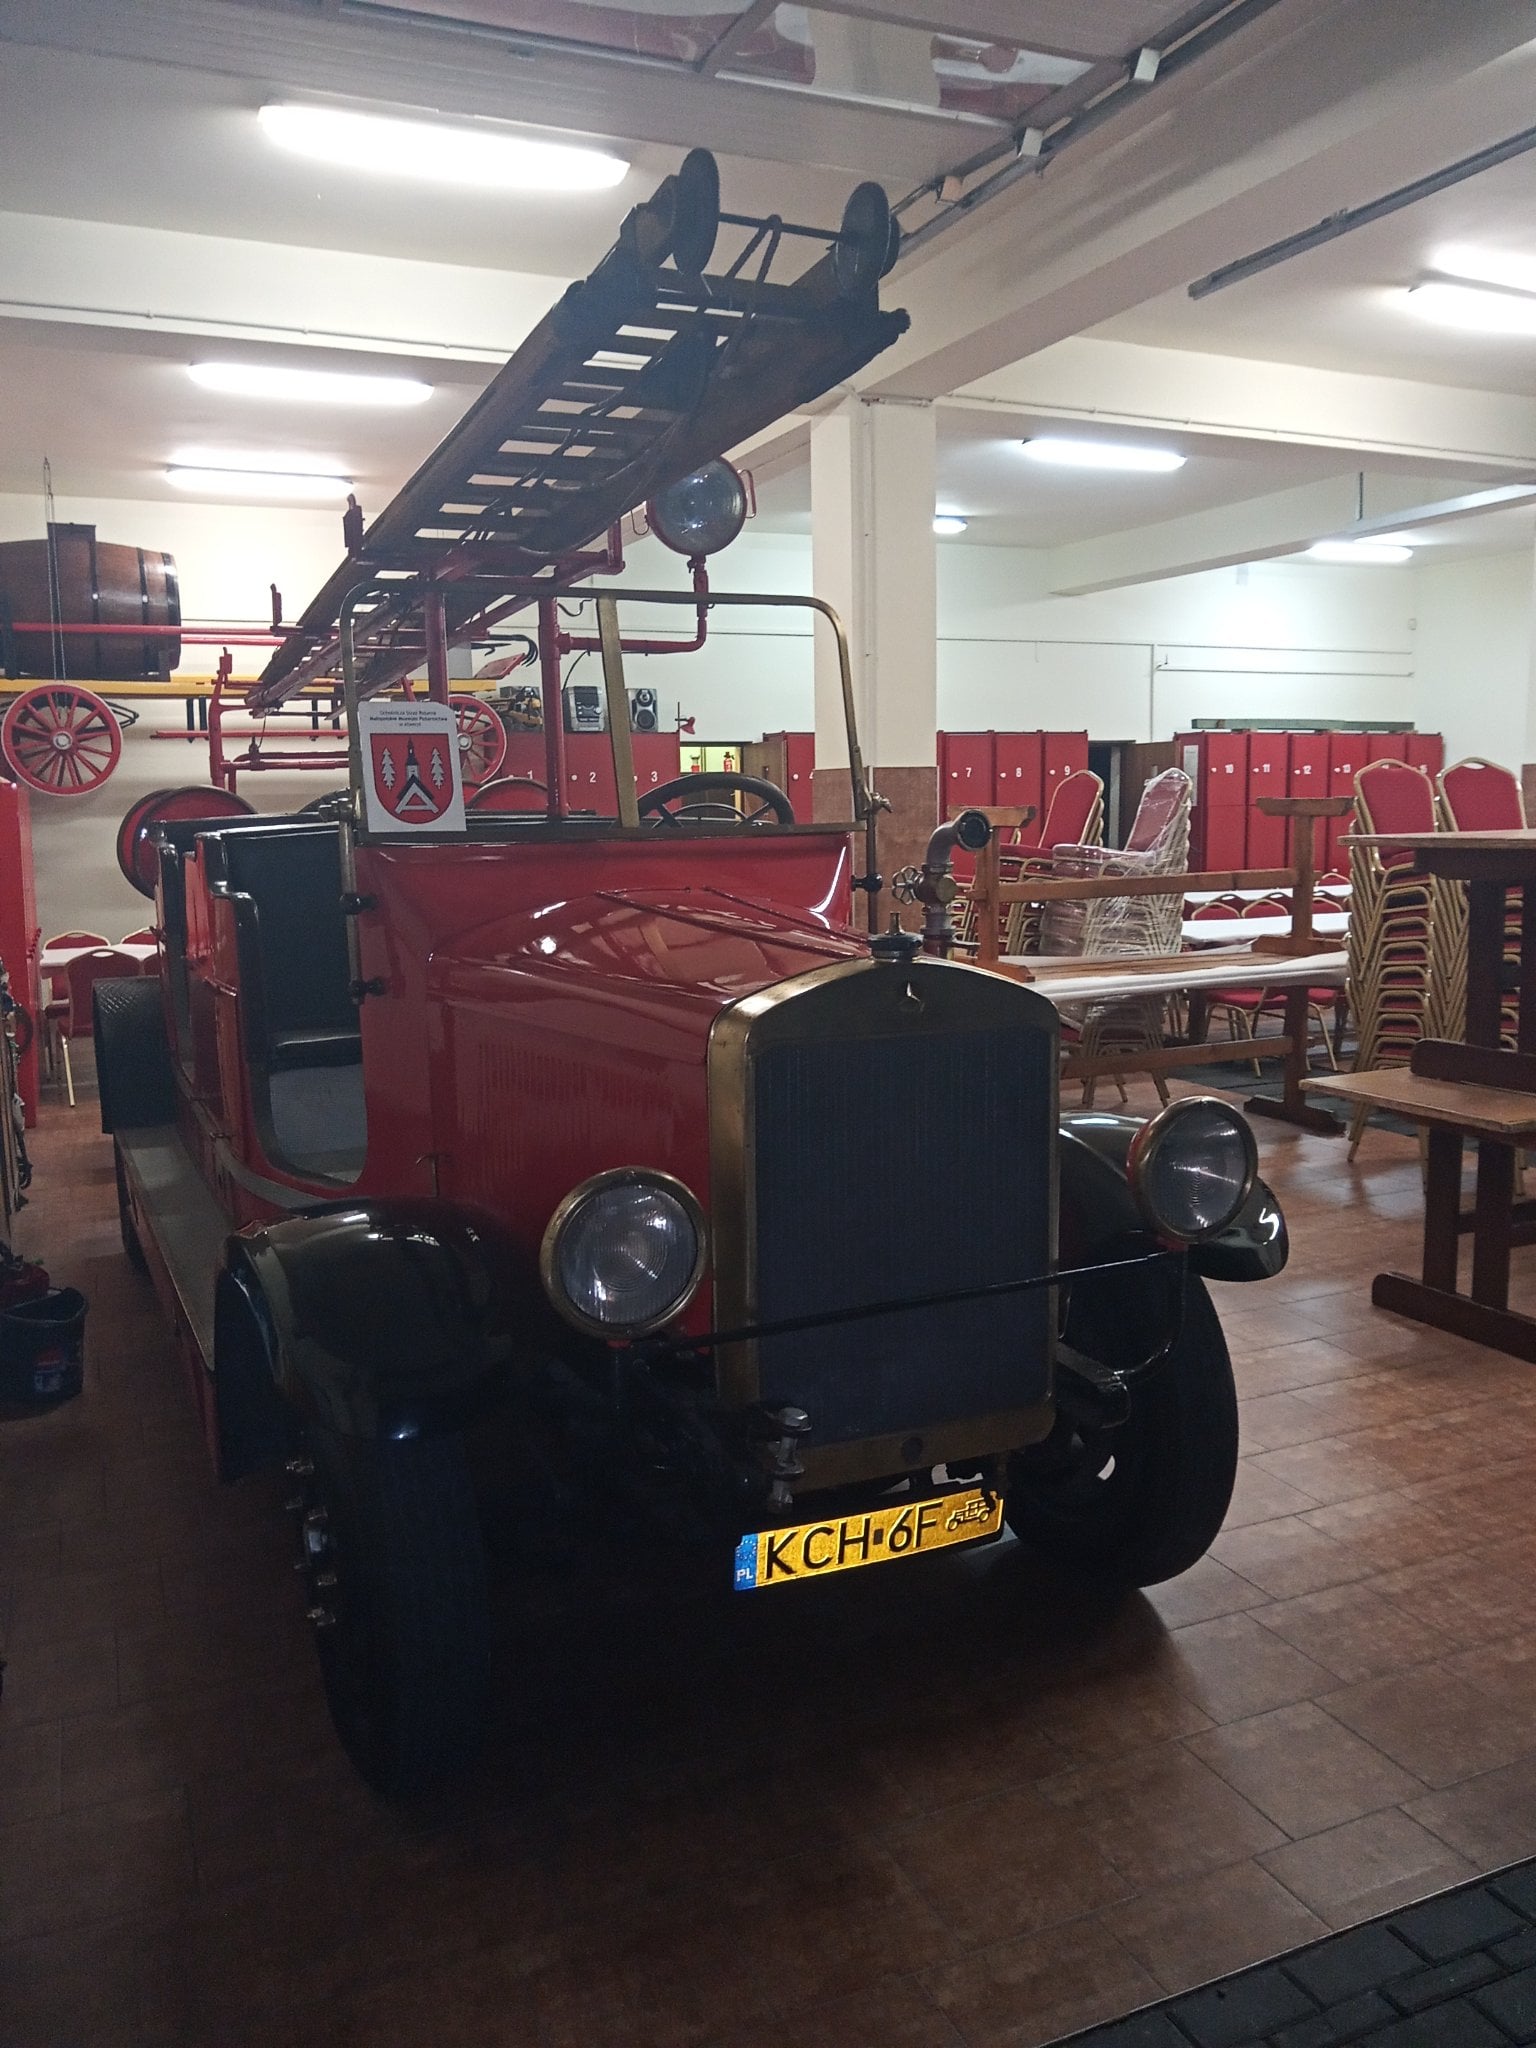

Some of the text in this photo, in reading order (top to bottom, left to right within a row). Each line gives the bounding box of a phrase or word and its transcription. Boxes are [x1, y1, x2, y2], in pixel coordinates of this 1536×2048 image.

[527, 770, 533, 780] 1
[965, 767, 972, 778] 7
[1015, 767, 1022, 778] 8
[1064, 765, 1070, 776] 9
[589, 771, 596, 783] 2
[651, 771, 658, 782] 3
[765, 1500, 943, 1579] KCH 6F
[736, 1567, 754, 1583] PL
